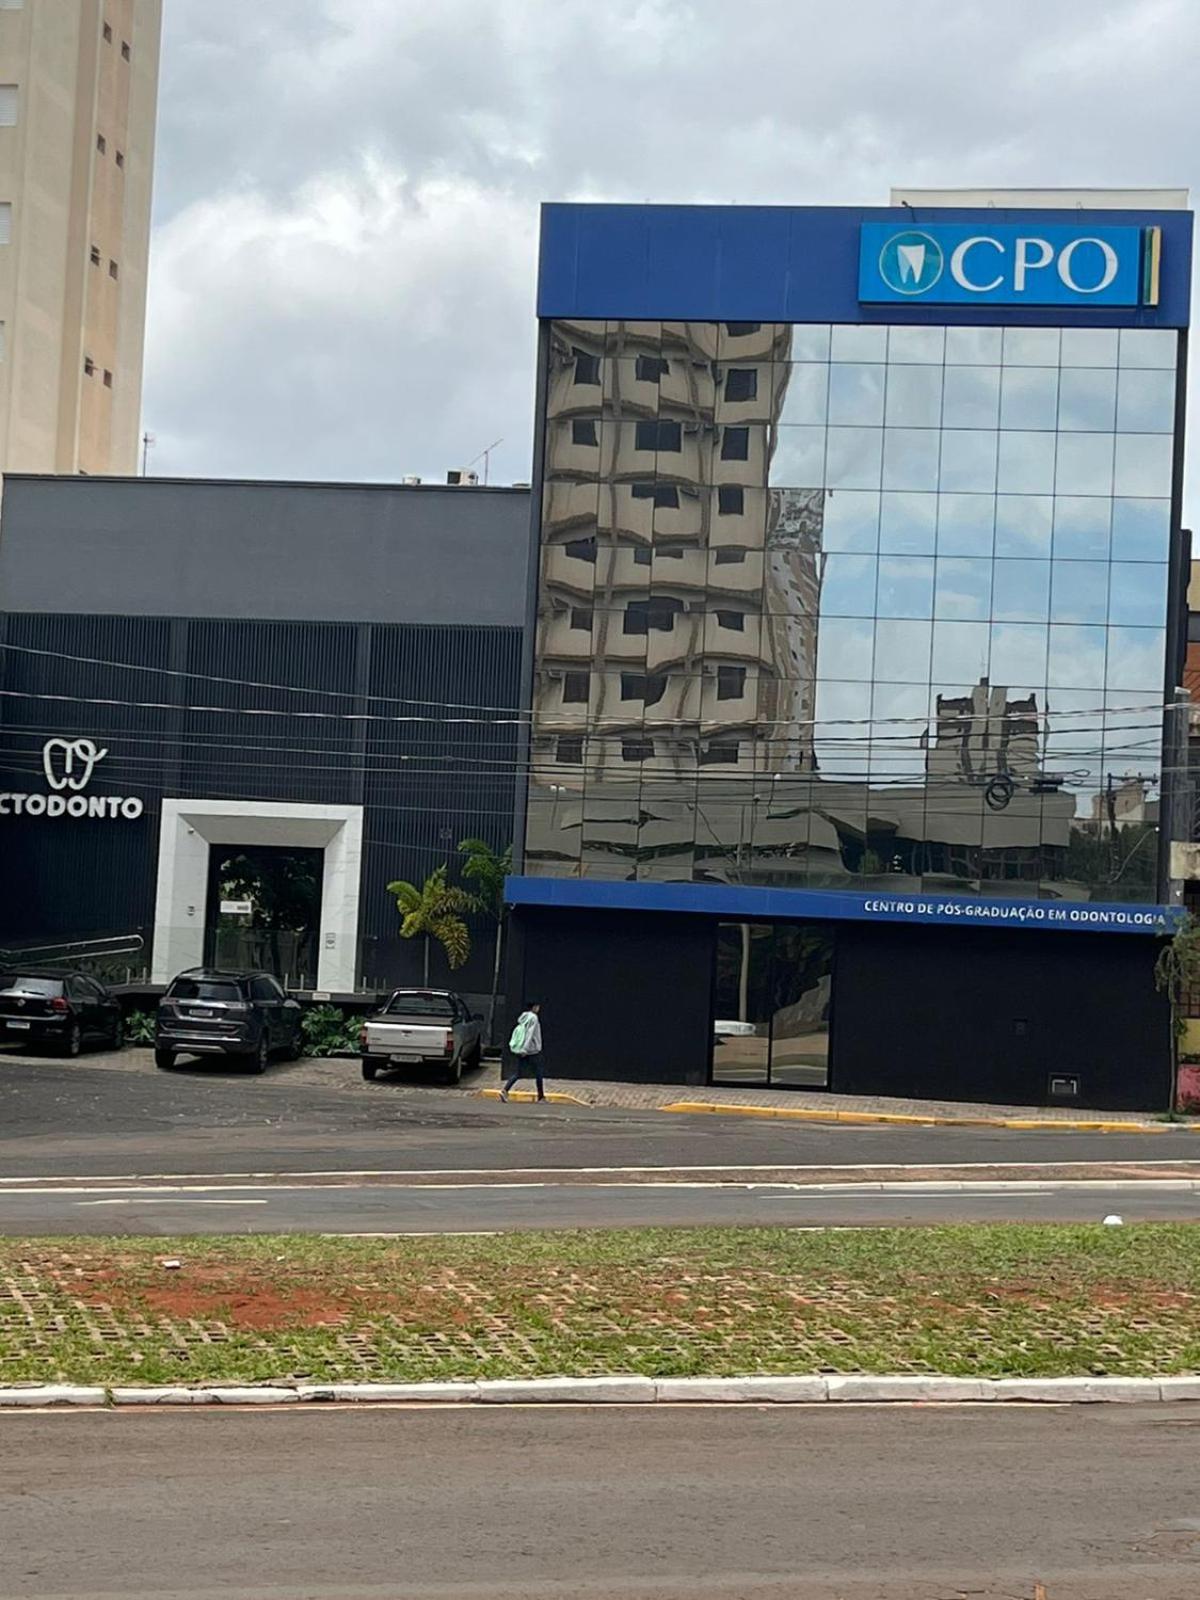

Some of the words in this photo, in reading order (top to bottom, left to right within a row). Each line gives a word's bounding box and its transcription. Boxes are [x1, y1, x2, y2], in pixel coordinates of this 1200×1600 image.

[950, 236, 1118, 293] CPO
[864, 900, 914, 913] CENTRO
[917, 903, 934, 914] DE
[936, 901, 1045, 921] PÓS-GRADUAÇÃO
[1048, 909, 1067, 920] EM
